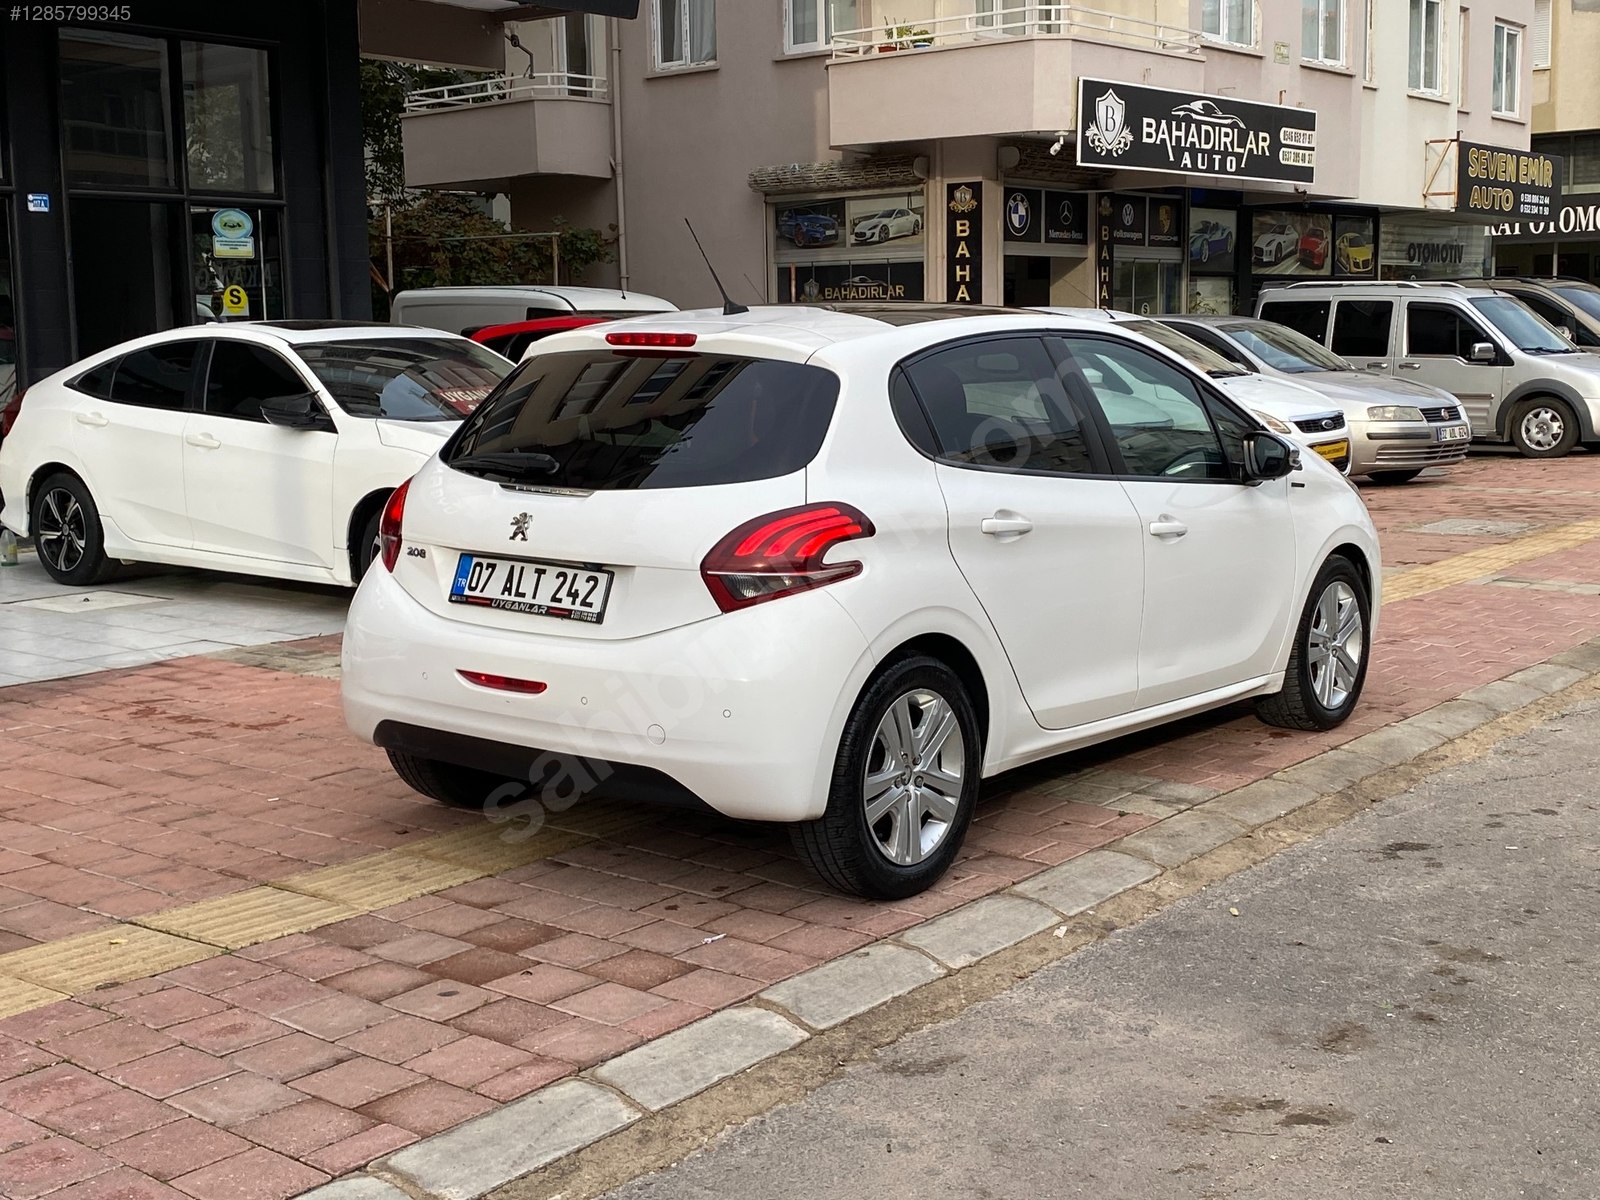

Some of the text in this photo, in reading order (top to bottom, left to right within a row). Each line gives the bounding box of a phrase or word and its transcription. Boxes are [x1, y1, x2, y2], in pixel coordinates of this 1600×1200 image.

[1105, 105, 1115, 132] B
[1142, 117, 1271, 168] BAHADIRLAR
[1181, 152, 1236, 172] AUTO
[1468, 147, 1517, 182] SEVEN
[1469, 185, 1514, 211] AUTO
[229, 288, 242, 305] S
[824, 285, 905, 301] BAHADIRLAR
[407, 547, 426, 559] 208
[457, 577, 466, 587] TR
[467, 561, 600, 608] 07 ALT 242
[491, 599, 549, 615] UYGANLAR
